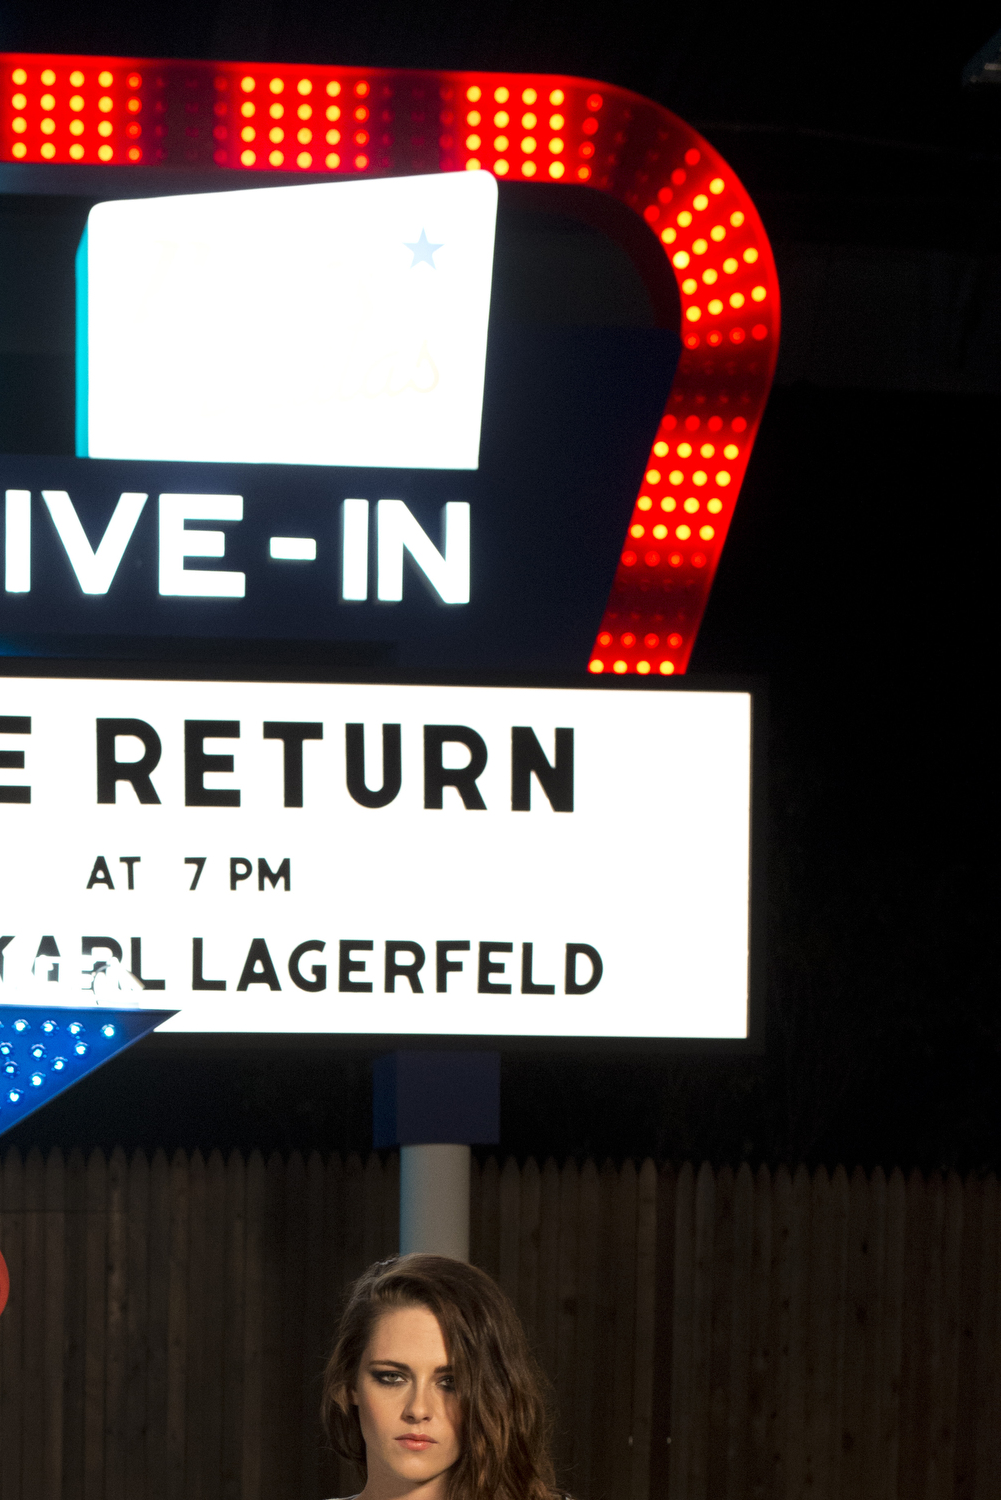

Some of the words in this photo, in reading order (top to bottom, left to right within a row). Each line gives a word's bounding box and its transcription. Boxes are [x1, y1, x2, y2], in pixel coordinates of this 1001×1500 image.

[97, 718, 574, 812] RETURN
[87, 857, 140, 889] AT
[185, 858, 206, 890] 7
[230, 858, 290, 891] PM
[192, 937, 603, 995] LAGERFELD
